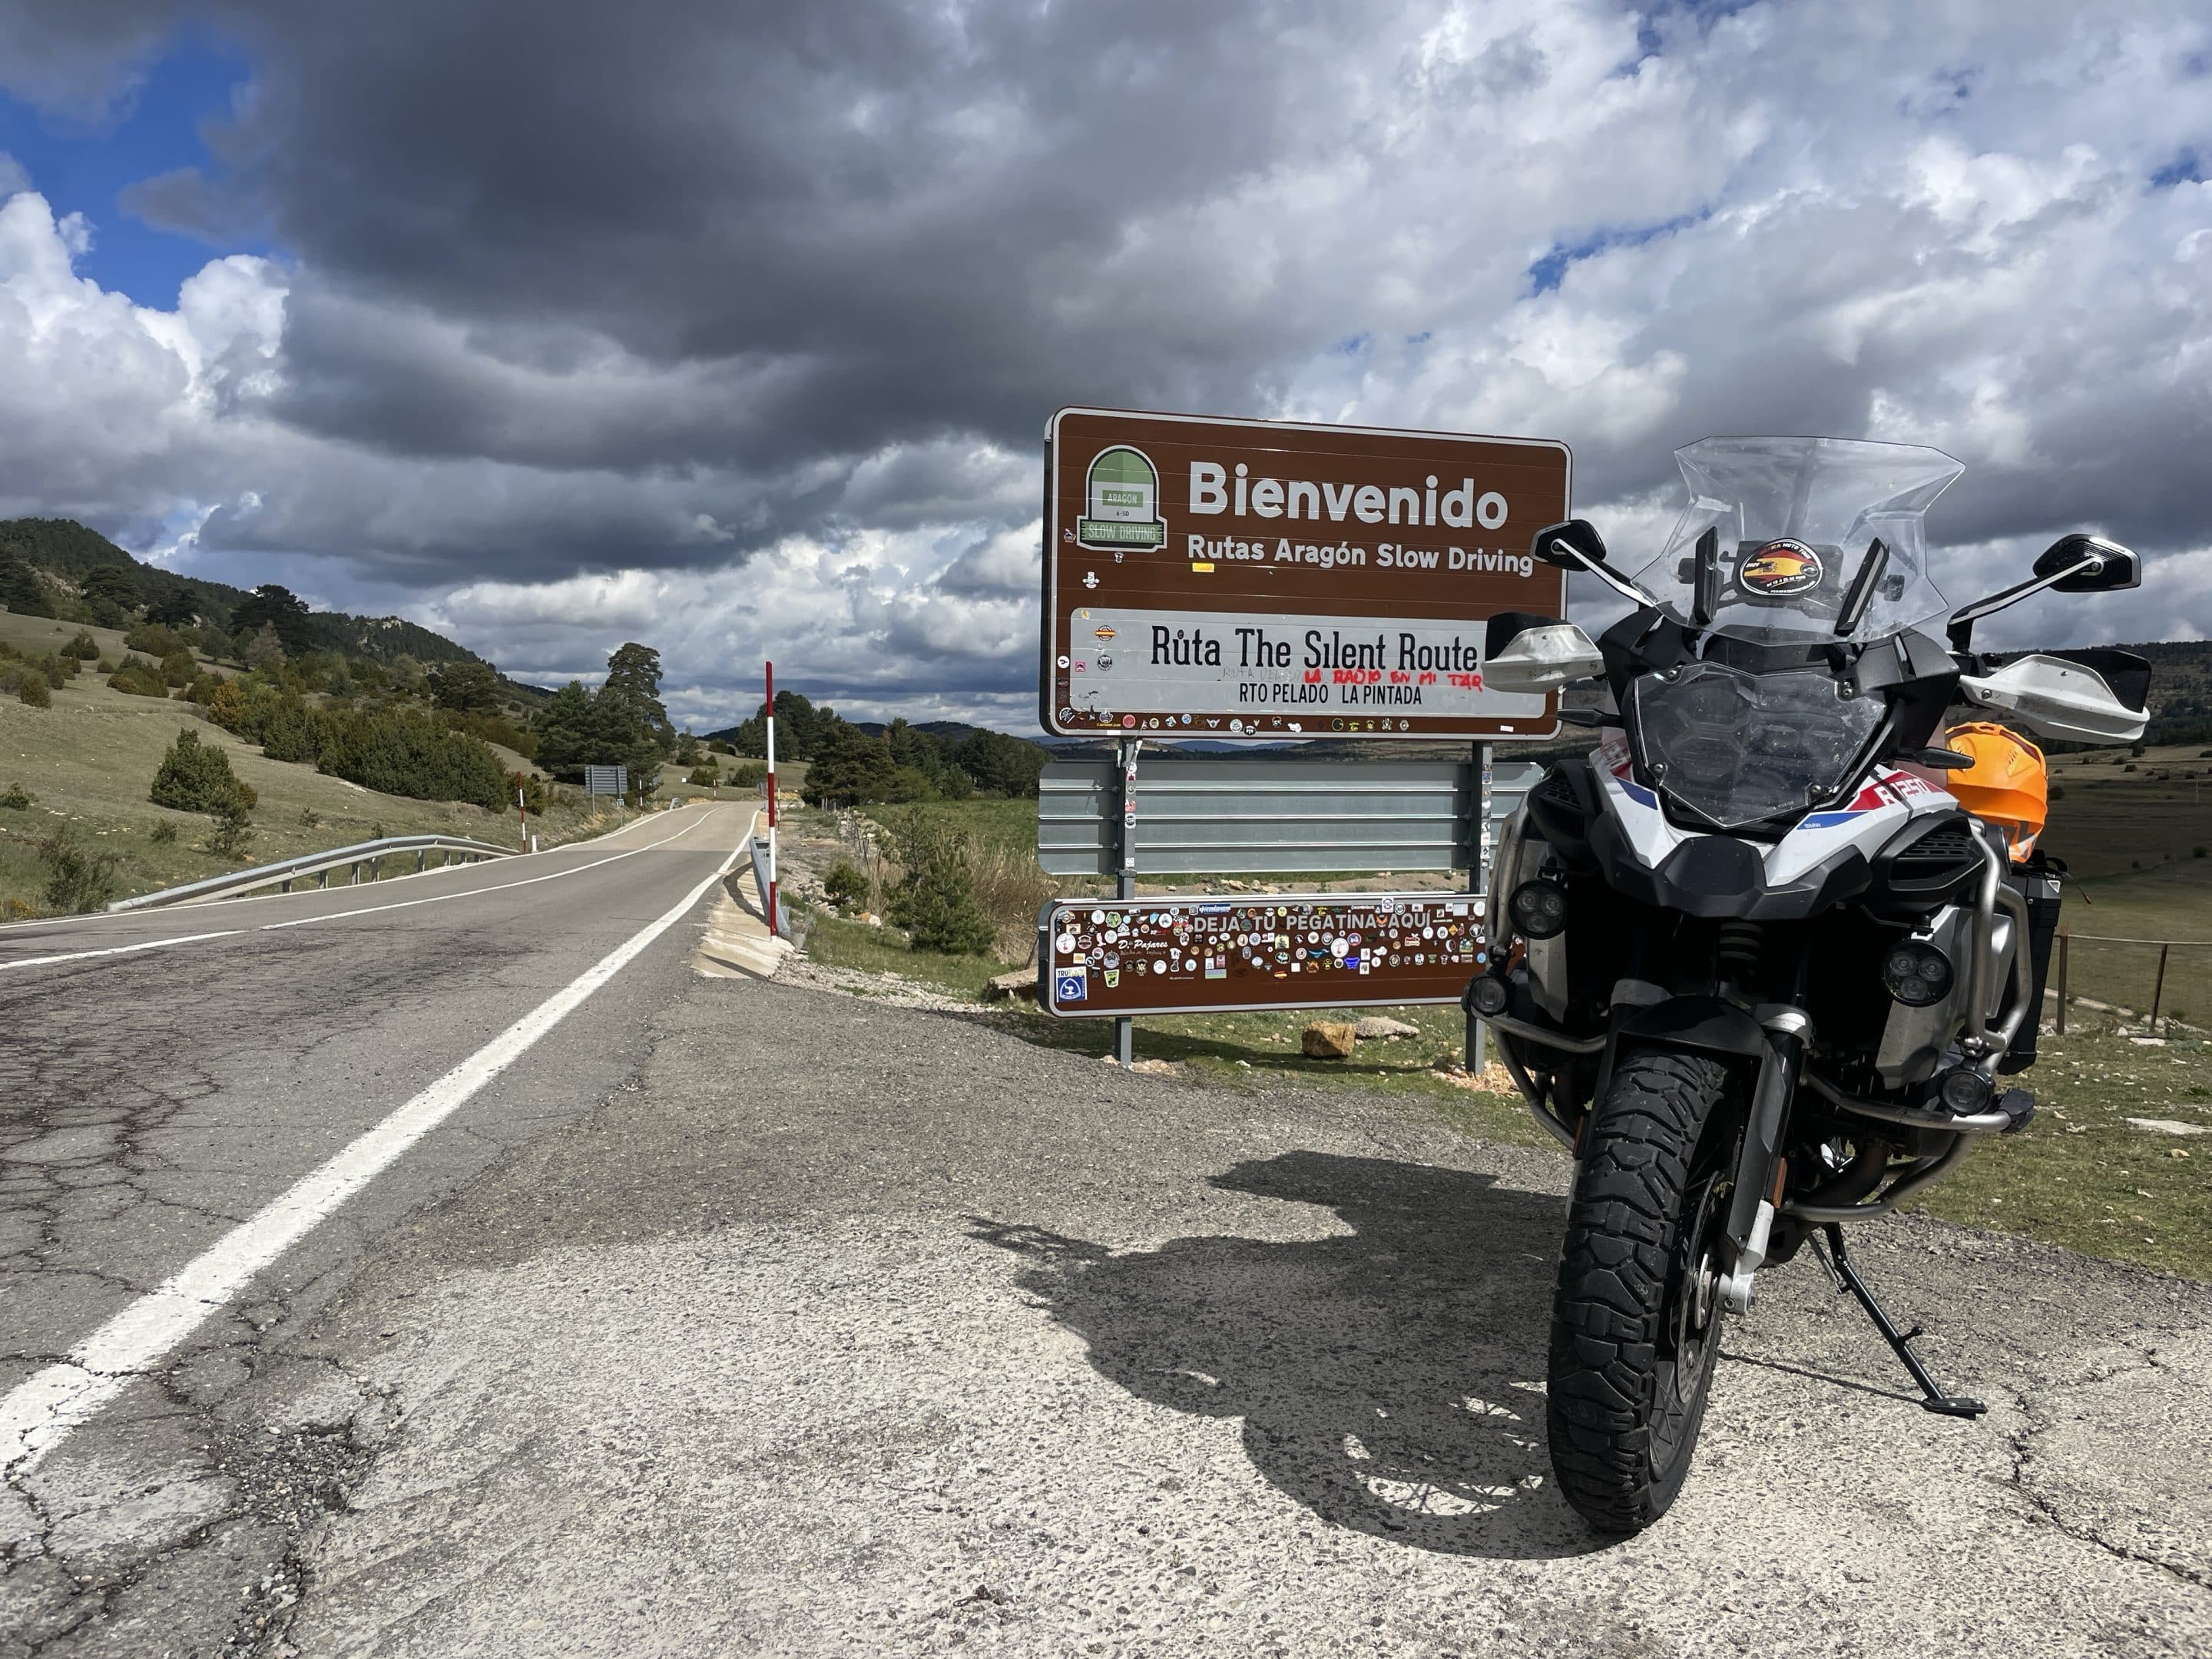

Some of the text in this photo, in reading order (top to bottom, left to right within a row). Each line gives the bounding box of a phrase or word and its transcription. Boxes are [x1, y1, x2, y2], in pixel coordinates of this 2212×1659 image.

[1190, 461, 1508, 530] Bienvenido
[1088, 524, 1156, 541] SLOW DRIVING
[1188, 535, 1533, 578] Rutas Aragón Slow Driving
[1151, 625, 1477, 671] Ruta The Silent Route
[1304, 669, 1322, 684] LA
[1390, 671, 1410, 684] EN
[1419, 672, 1436, 685] MI
[1240, 683, 1422, 704] RTO PELADO LA PINTADA
[1874, 778, 1932, 806] R 1250
[1194, 916, 1240, 932] DEJA
[1253, 916, 1276, 931] TU
[1286, 914, 1377, 930] PEGATINA
[1388, 909, 1431, 929] AQUÍ
